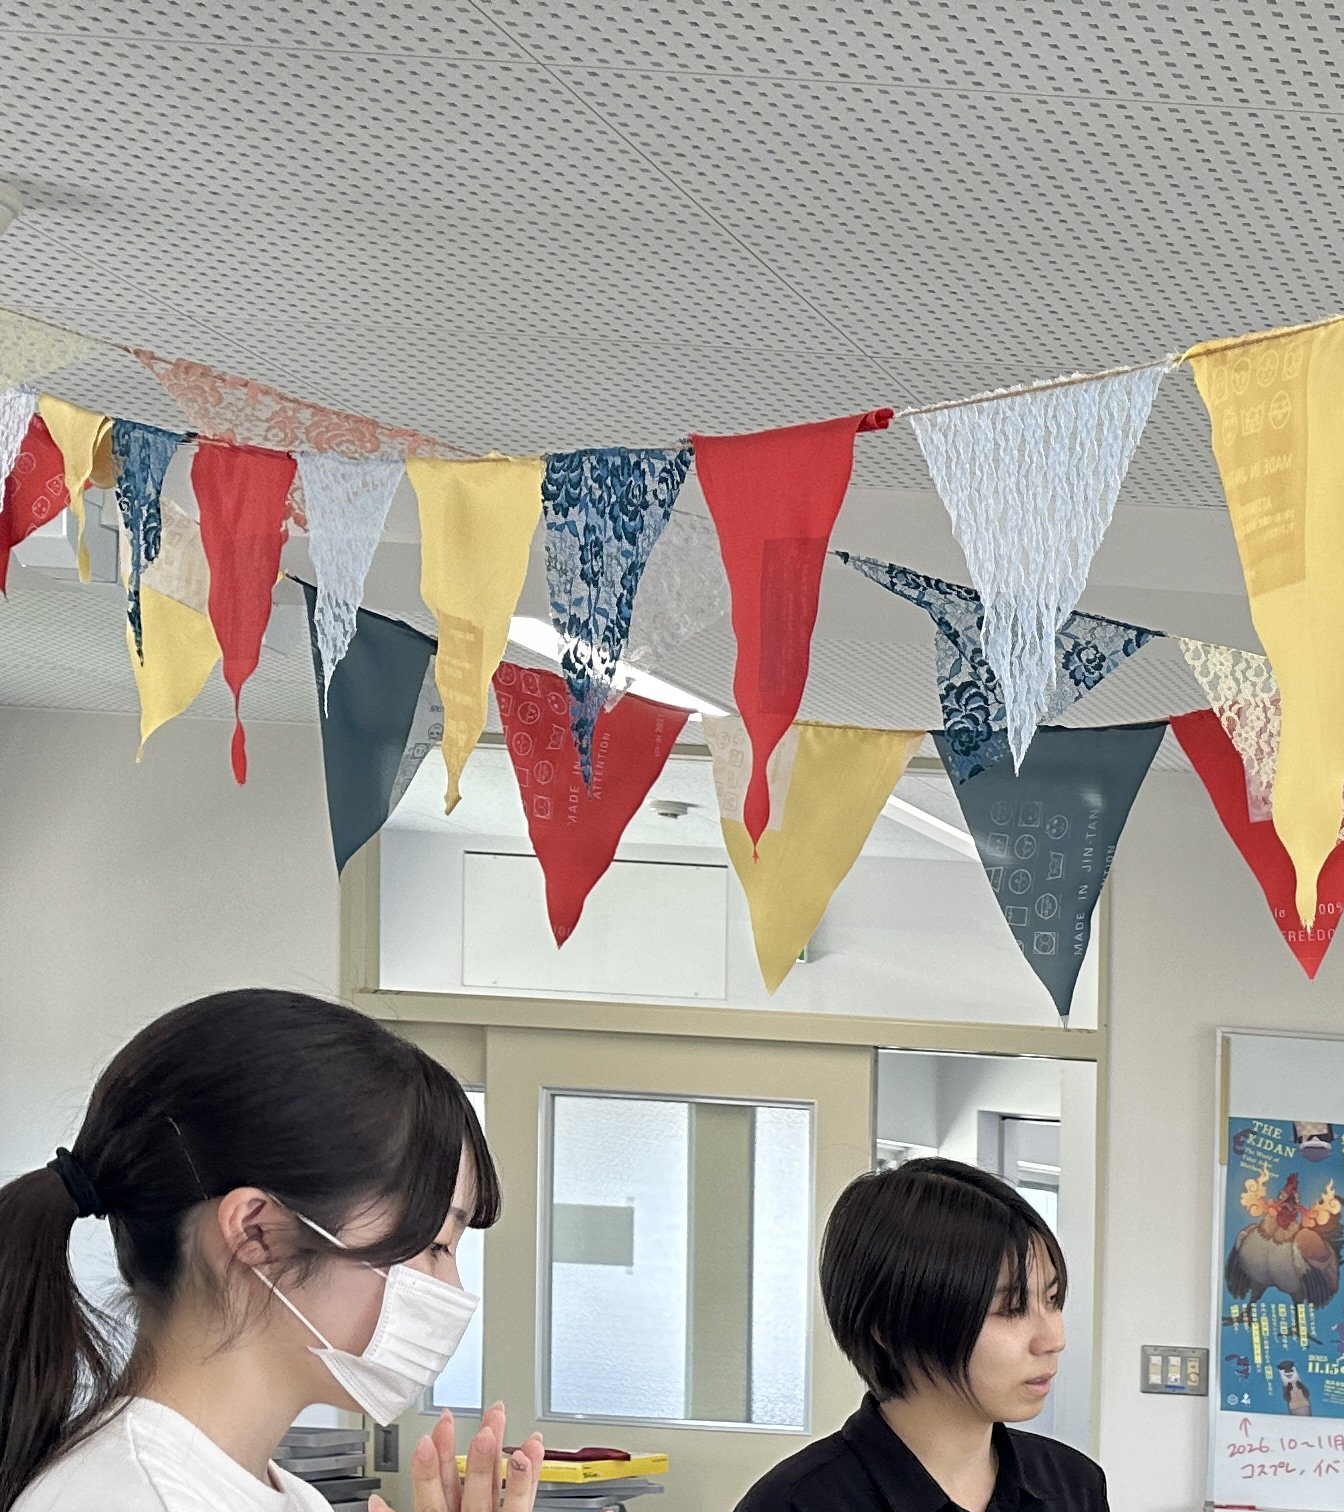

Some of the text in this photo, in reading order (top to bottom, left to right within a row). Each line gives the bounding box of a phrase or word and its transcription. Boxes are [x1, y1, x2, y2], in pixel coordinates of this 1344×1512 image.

[592, 732, 611, 800] ATTENTION
[567, 785, 578, 825] MADE
[1073, 808, 1101, 957] MADE IN JIN-TAN
[1246, 1133, 1297, 1159] KIDAN
[1252, 1120, 1283, 1140] THE
